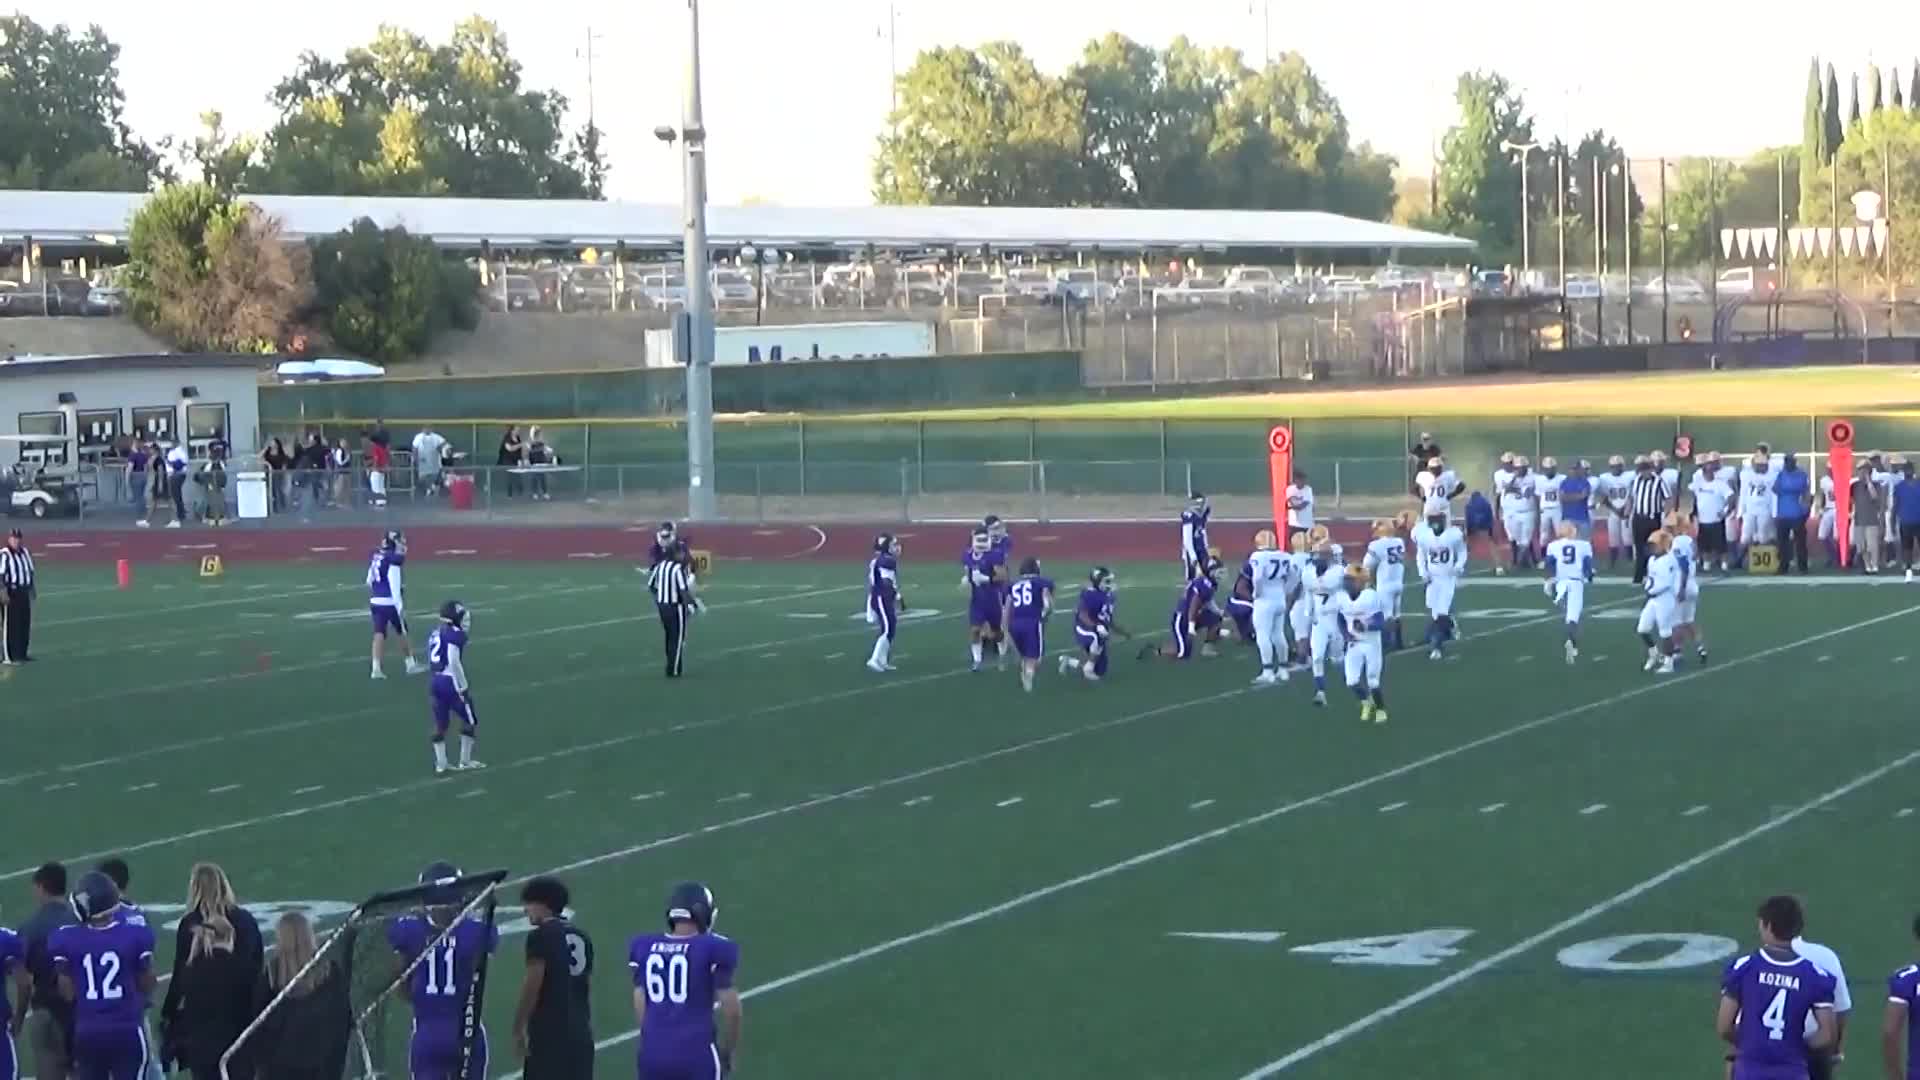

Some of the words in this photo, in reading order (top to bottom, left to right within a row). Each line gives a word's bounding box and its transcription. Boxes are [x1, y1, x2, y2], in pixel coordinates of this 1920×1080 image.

[1429, 546, 1450, 564] 20
[1562, 545, 1577, 565] 9
[1751, 551, 1772, 568] 30
[1011, 580, 1033, 608] 56
[426, 947, 457, 995] 11
[565, 934, 587, 977] 3
[83, 951, 122, 999] 12
[646, 953, 688, 1003] 60
[1758, 971, 1800, 991] KOZINA
[1761, 988, 1789, 1041] 4
